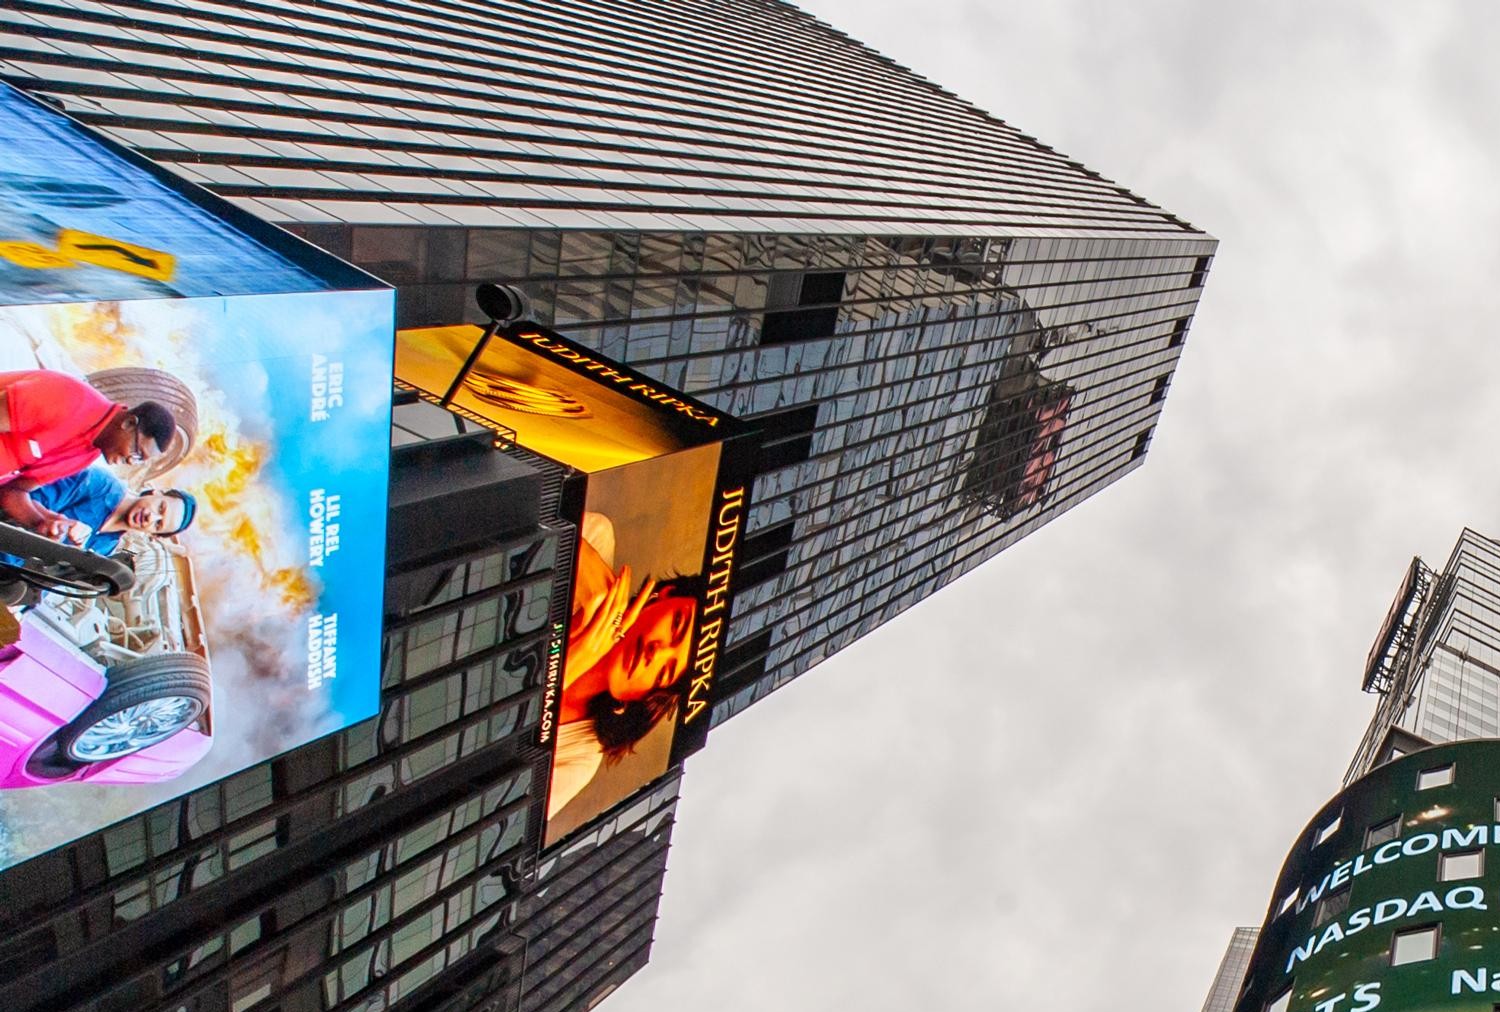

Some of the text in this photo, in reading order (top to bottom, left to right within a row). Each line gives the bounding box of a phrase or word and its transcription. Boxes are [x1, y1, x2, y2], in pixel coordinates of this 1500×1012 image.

[310, 352, 330, 423] ANDRÉ
[327, 361, 344, 409] ERIC
[519, 332, 720, 427] JUDITH RIPKA
[309, 488, 326, 568] HOWERY
[325, 494, 341, 557] LIL REL
[685, 486, 744, 724] JUDITH RIPKA
[307, 613, 323, 691] HADDISH
[322, 612, 338, 679] TIFFANY
[1286, 886, 1487, 974] NASDAQ
